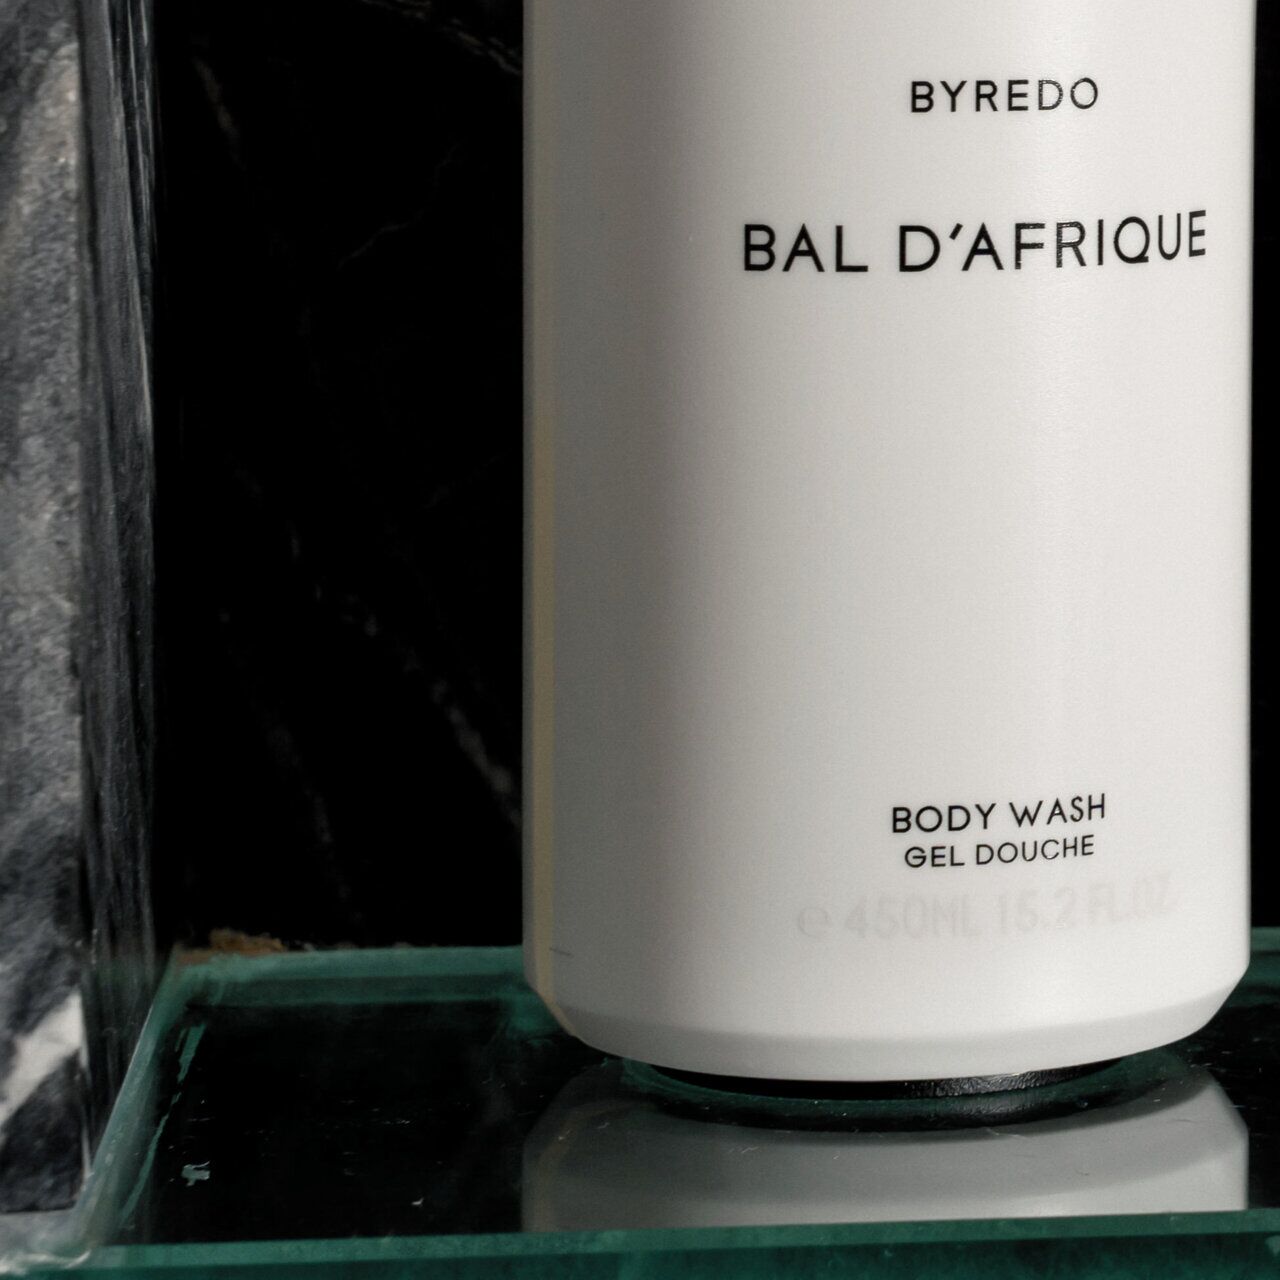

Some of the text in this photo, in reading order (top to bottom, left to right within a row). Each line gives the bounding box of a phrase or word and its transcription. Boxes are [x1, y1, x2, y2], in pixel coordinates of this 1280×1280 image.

[909, 74, 1100, 115] BYREDO
[742, 207, 1208, 275] BAL D'AFRIQUE
[889, 792, 1107, 835] BODY WASH
[903, 833, 1097, 870] GEL DOUCHE
[844, 893, 982, 940] 450ML
[998, 887, 1077, 934] 15.2
